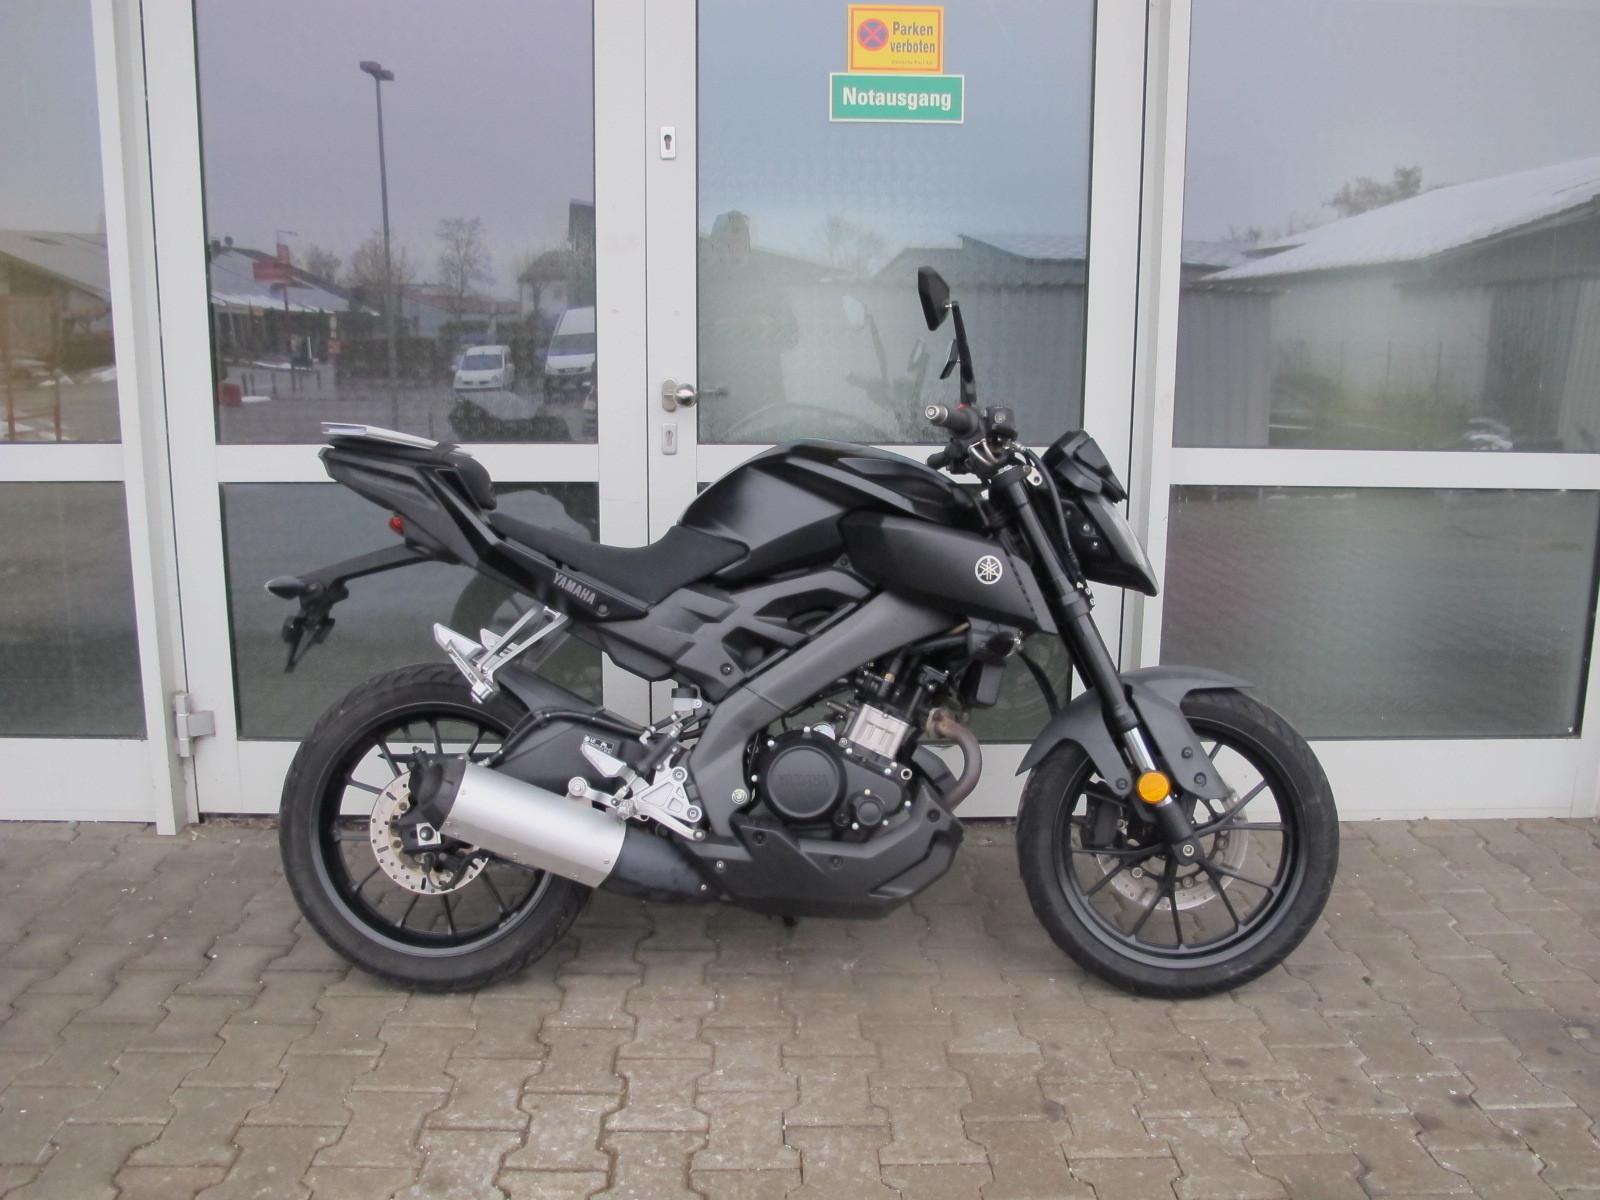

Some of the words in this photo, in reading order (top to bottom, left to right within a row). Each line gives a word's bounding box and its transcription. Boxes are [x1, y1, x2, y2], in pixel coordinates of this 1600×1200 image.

[892, 21, 934, 36] Parken
[890, 40, 936, 54] verboten
[842, 86, 952, 111] Notausgang
[553, 571, 596, 605] YAMAHA
